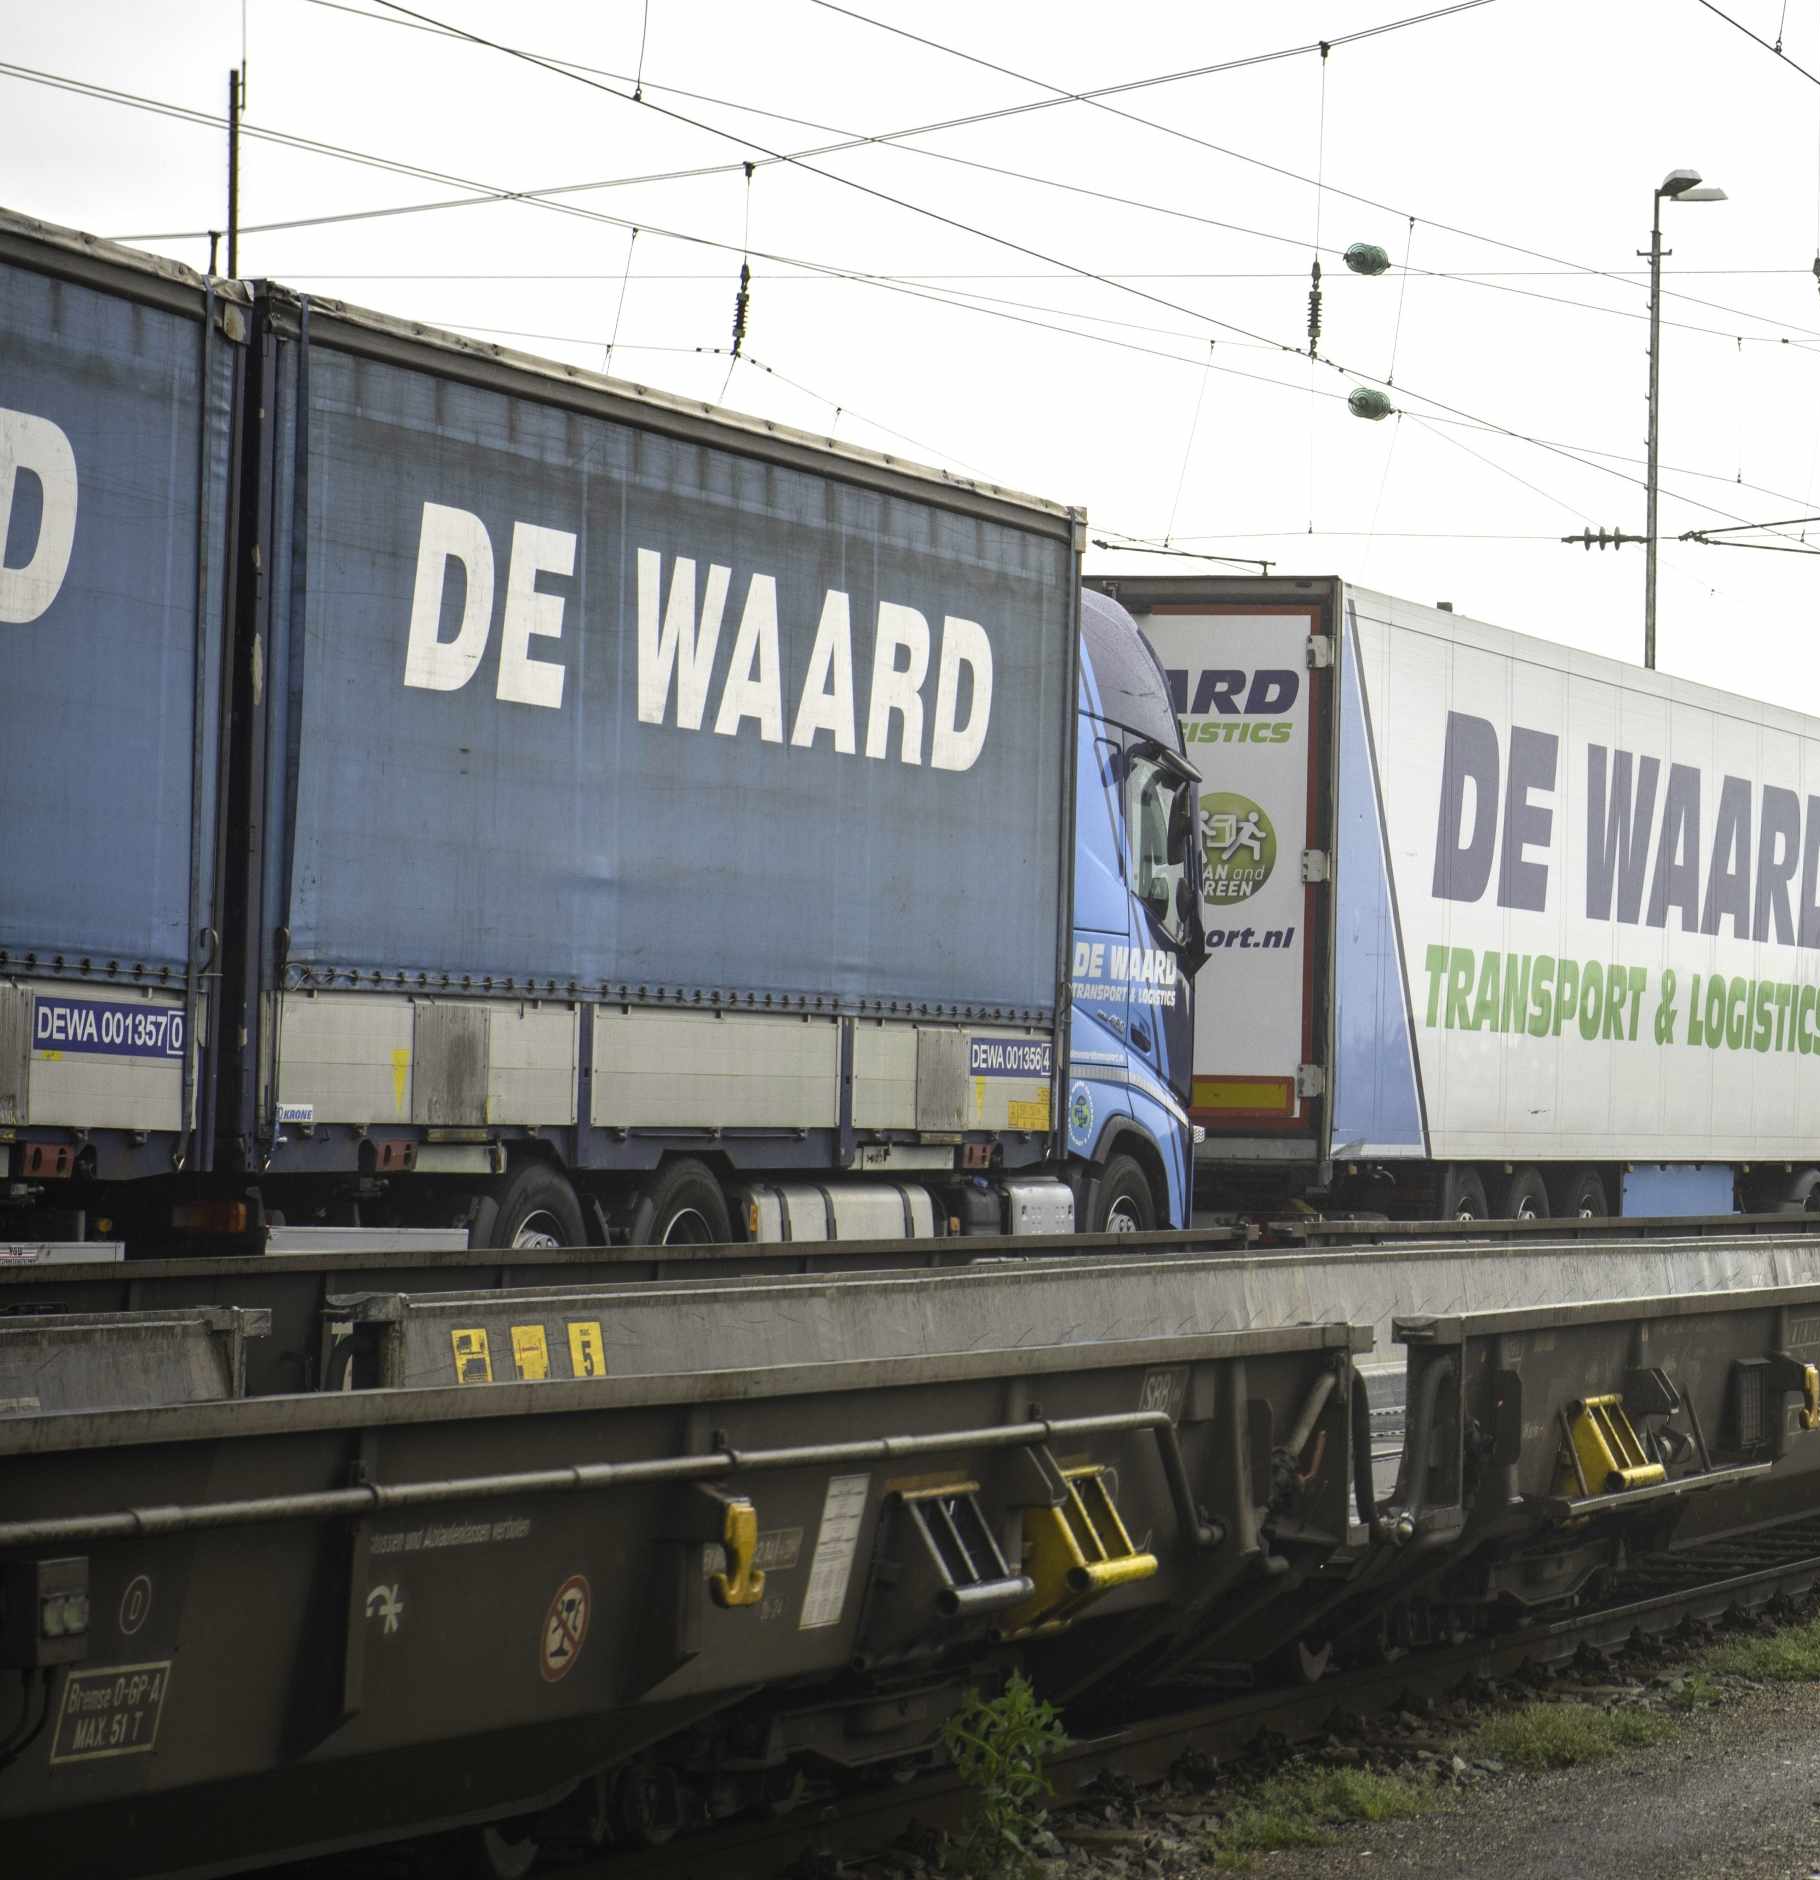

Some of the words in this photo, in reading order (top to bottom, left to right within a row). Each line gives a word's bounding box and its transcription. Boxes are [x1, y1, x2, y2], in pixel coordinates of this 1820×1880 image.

[404, 501, 577, 709] DE
[637, 548, 994, 772] WAARD
[1432, 710, 1559, 912] DE
[1233, 866, 1265, 881] and
[1072, 943, 1105, 978] DE
[1111, 945, 1177, 985] WAARD
[1071, 982, 1128, 1002] TRANSPORT
[1138, 988, 1176, 1007] LOGISTICS
[1424, 943, 1647, 1041] TRANSPORT
[1654, 968, 1678, 1046] &
[38, 1006, 98, 1042] DEWA
[972, 1044, 1004, 1068] DEWA
[581, 1340, 595, 1377] 5
[110, 1714, 128, 1744] 51
[132, 1711, 143, 1741] T
